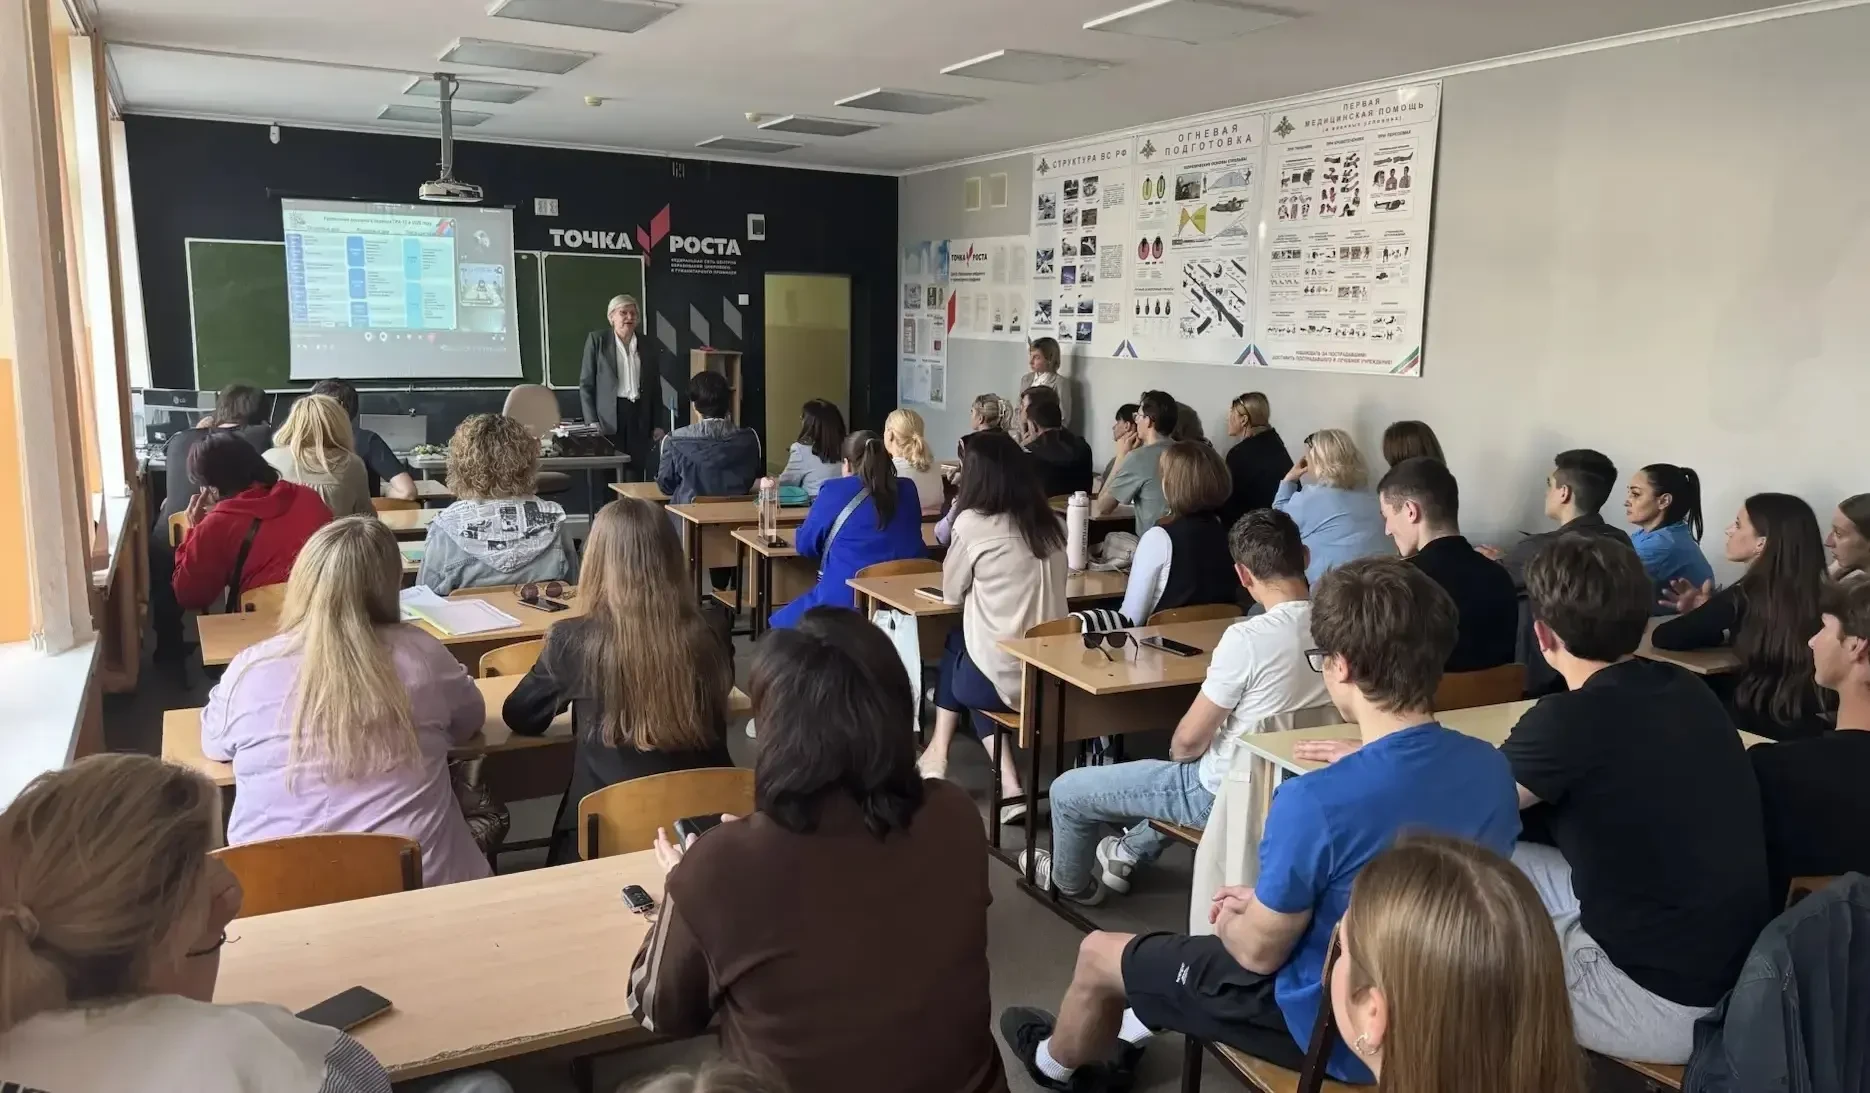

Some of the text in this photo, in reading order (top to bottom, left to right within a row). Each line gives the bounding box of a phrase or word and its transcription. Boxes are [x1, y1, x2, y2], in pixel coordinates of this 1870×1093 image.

[1305, 102, 1424, 127] МЕДИЦИНСКАЯ ПОМОЩЬ
[1343, 98, 1380, 111] ПЕРВАЯ
[1178, 124, 1238, 142] ОГНЕВАЯ
[1165, 134, 1252, 156] ПОДГОТОВКА
[1053, 149, 1127, 169] СТРУКТУРА ВС РФ
[549, 228, 741, 256] ТОЧКА РОСТА
[972, 253, 988, 261] РОСТА
